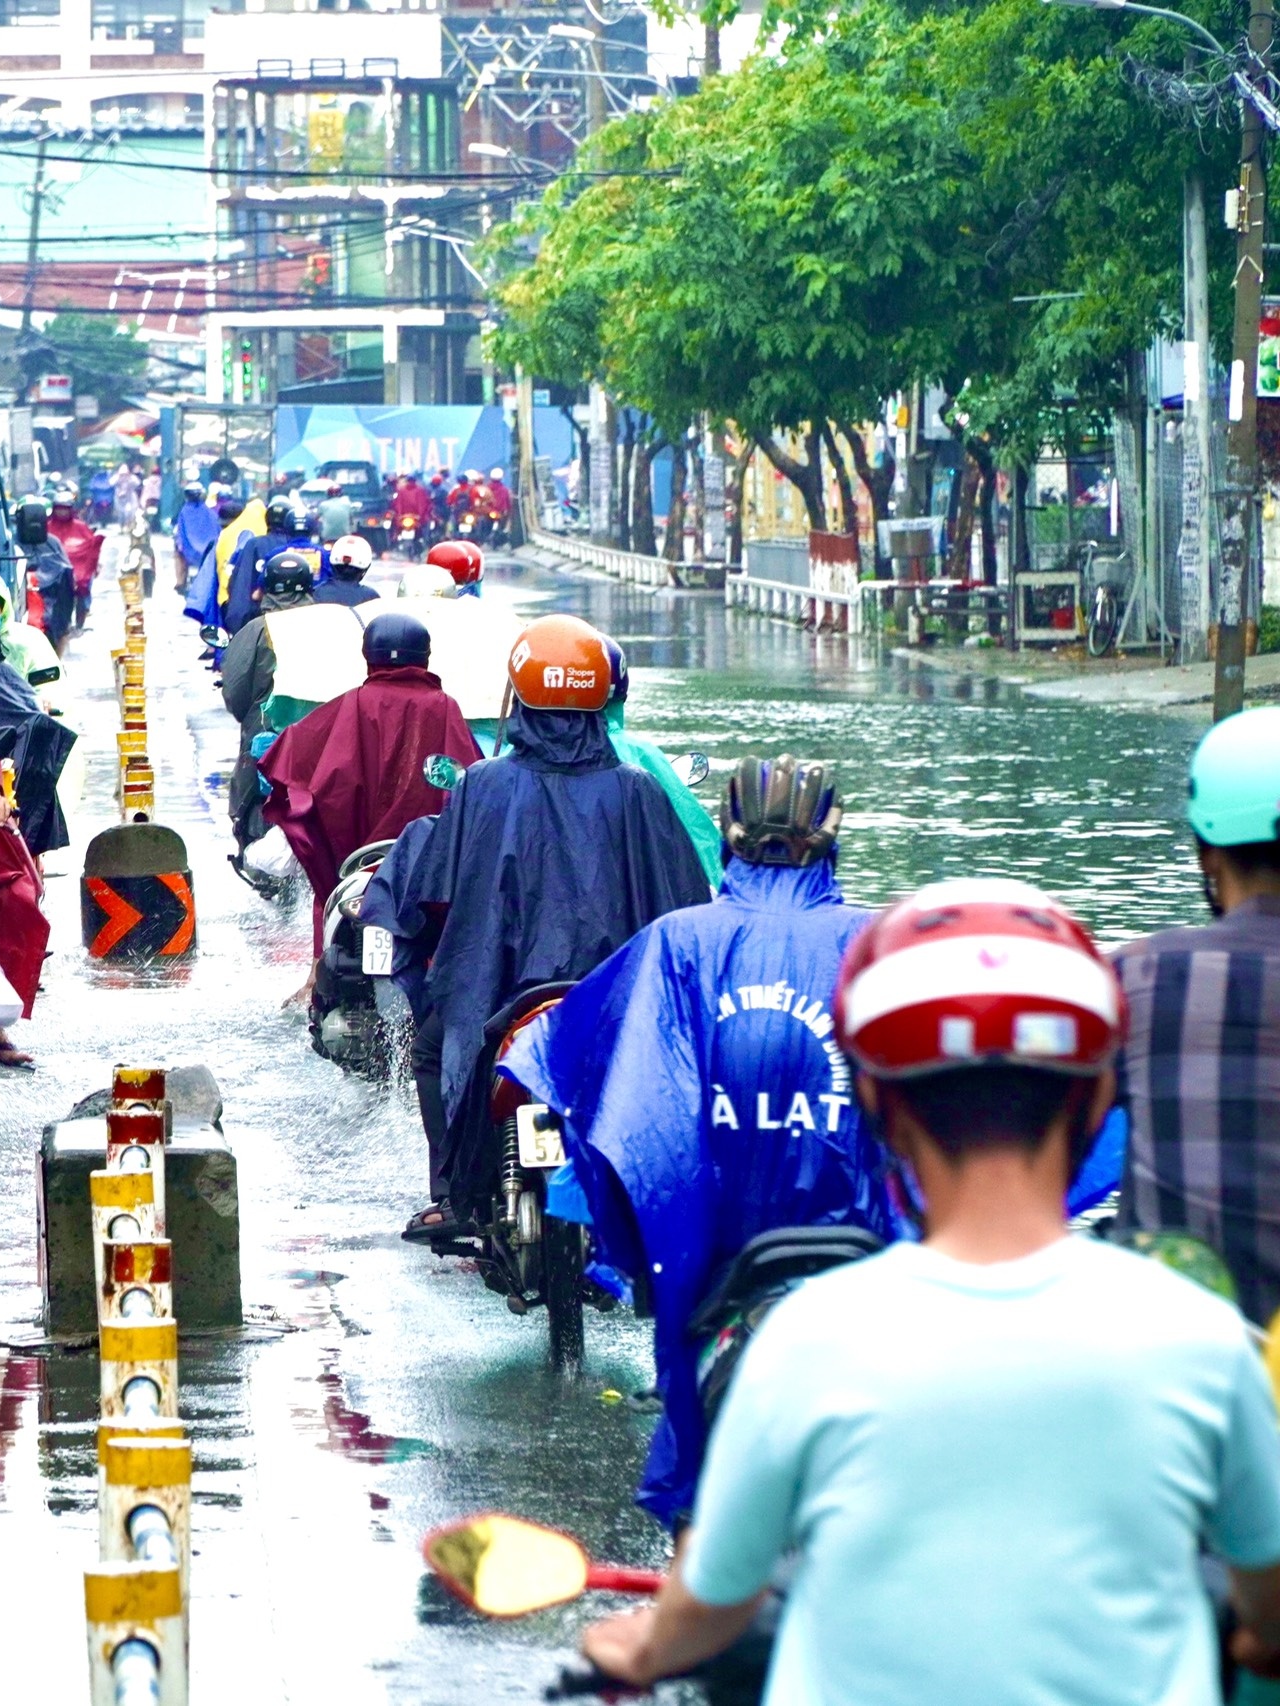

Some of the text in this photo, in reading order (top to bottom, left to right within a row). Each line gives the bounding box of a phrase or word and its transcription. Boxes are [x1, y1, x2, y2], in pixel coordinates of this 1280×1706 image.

[567, 667, 595, 677] Shopee
[566, 677, 595, 688] Food
[375, 931, 392, 949] 59
[757, 1092, 851, 1138] LẠT
